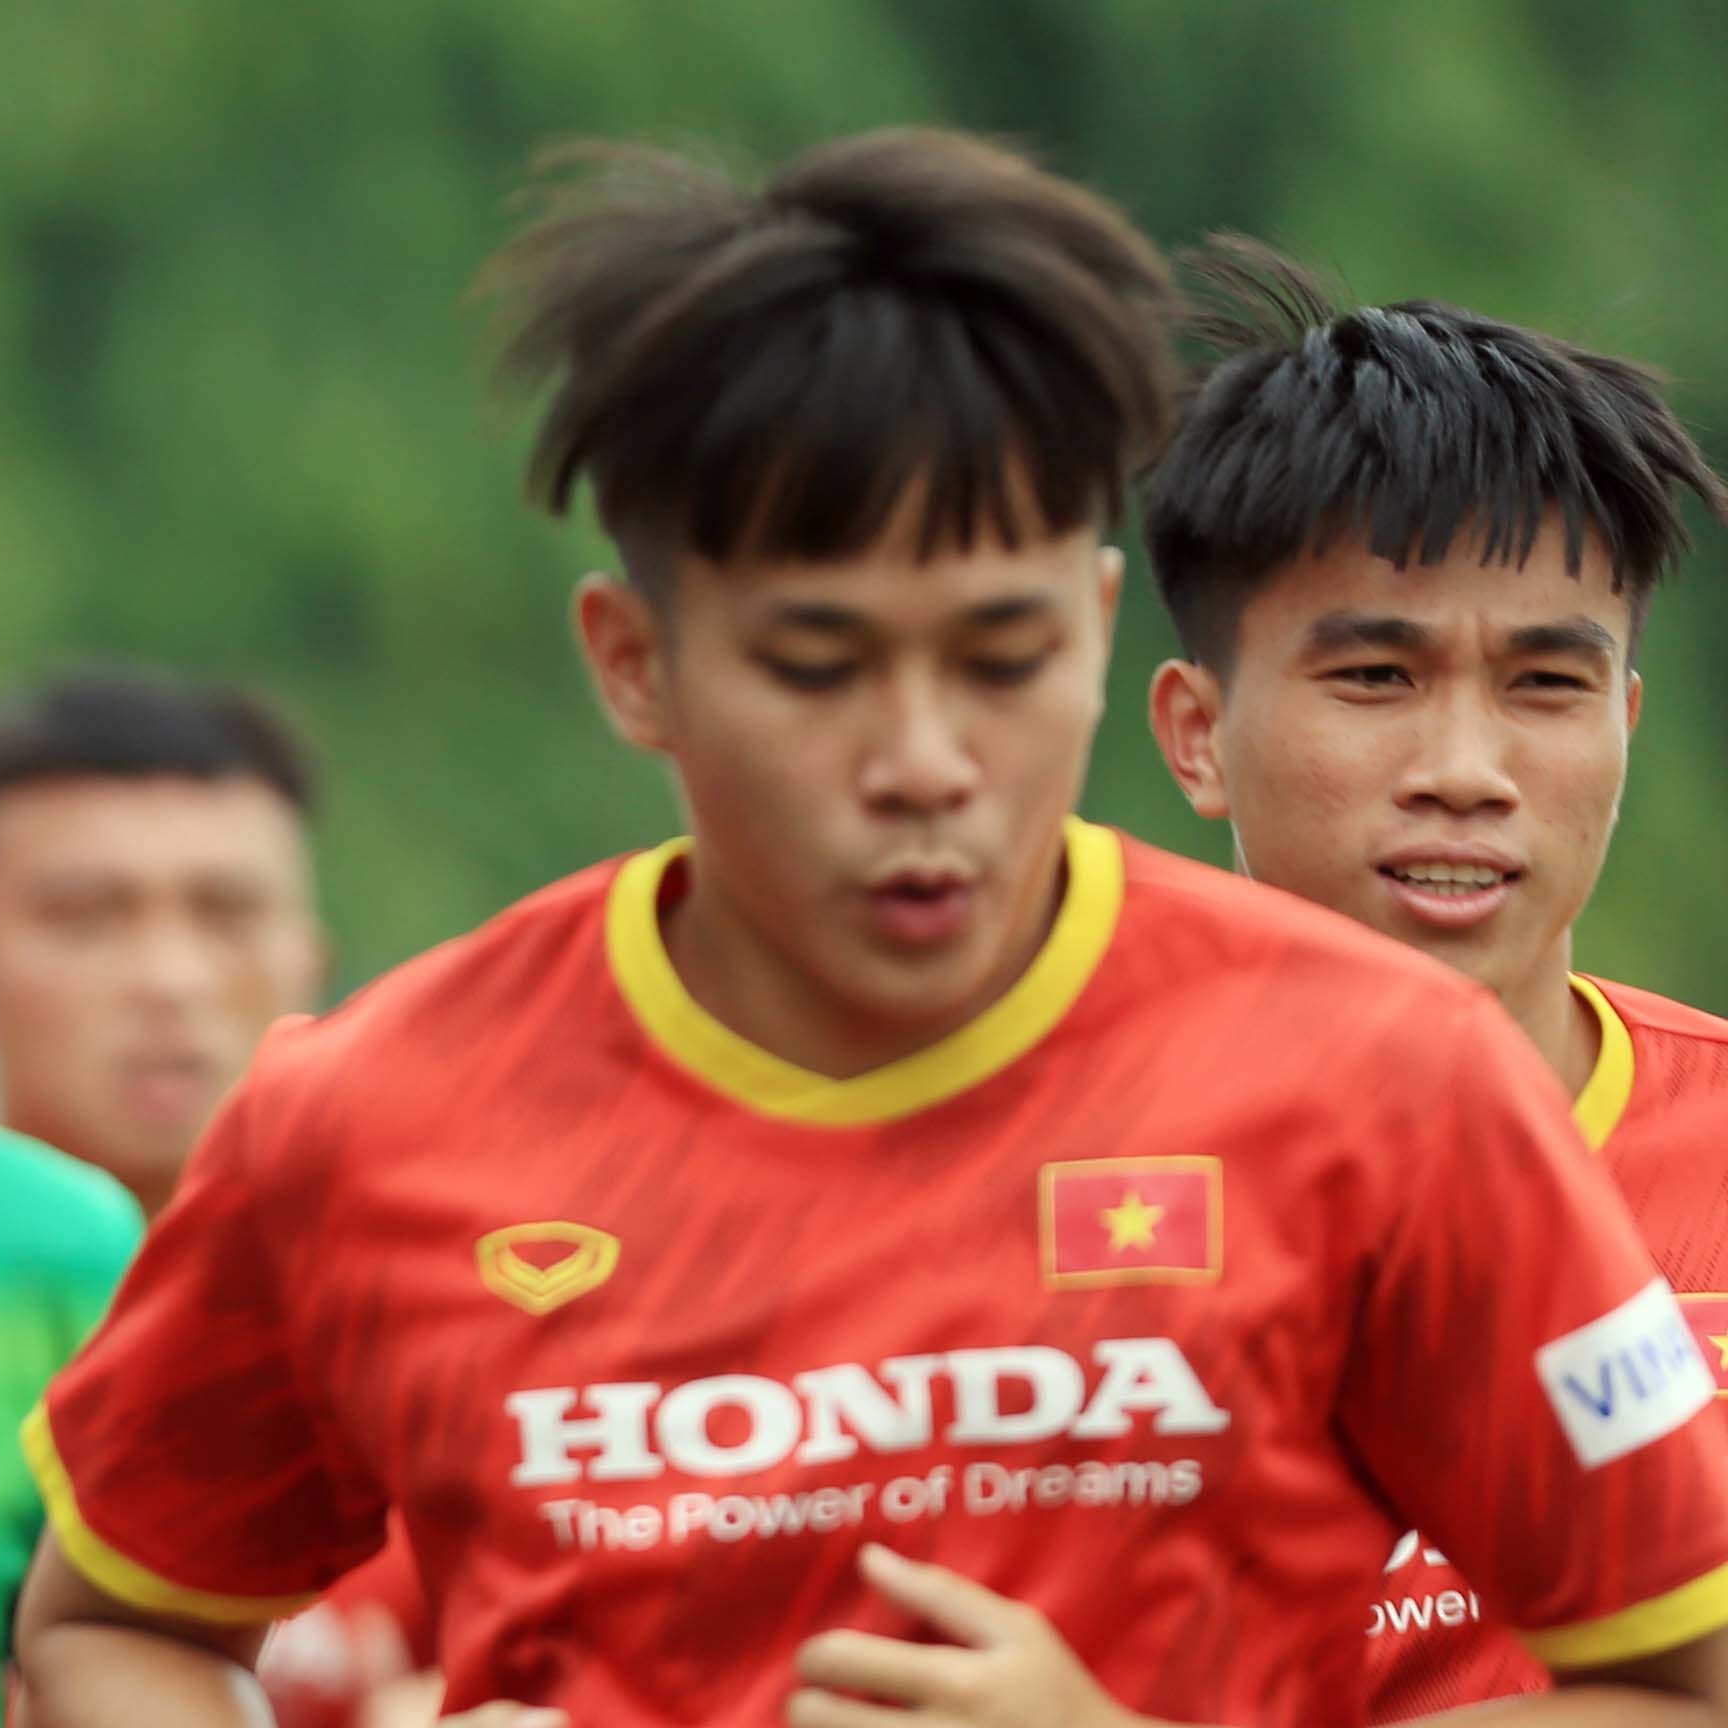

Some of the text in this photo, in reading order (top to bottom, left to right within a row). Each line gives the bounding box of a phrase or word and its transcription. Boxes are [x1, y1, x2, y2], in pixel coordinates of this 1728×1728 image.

[506, 1337, 1231, 1487] HONDA
[539, 1458, 1202, 1551] The Power of Dreams
